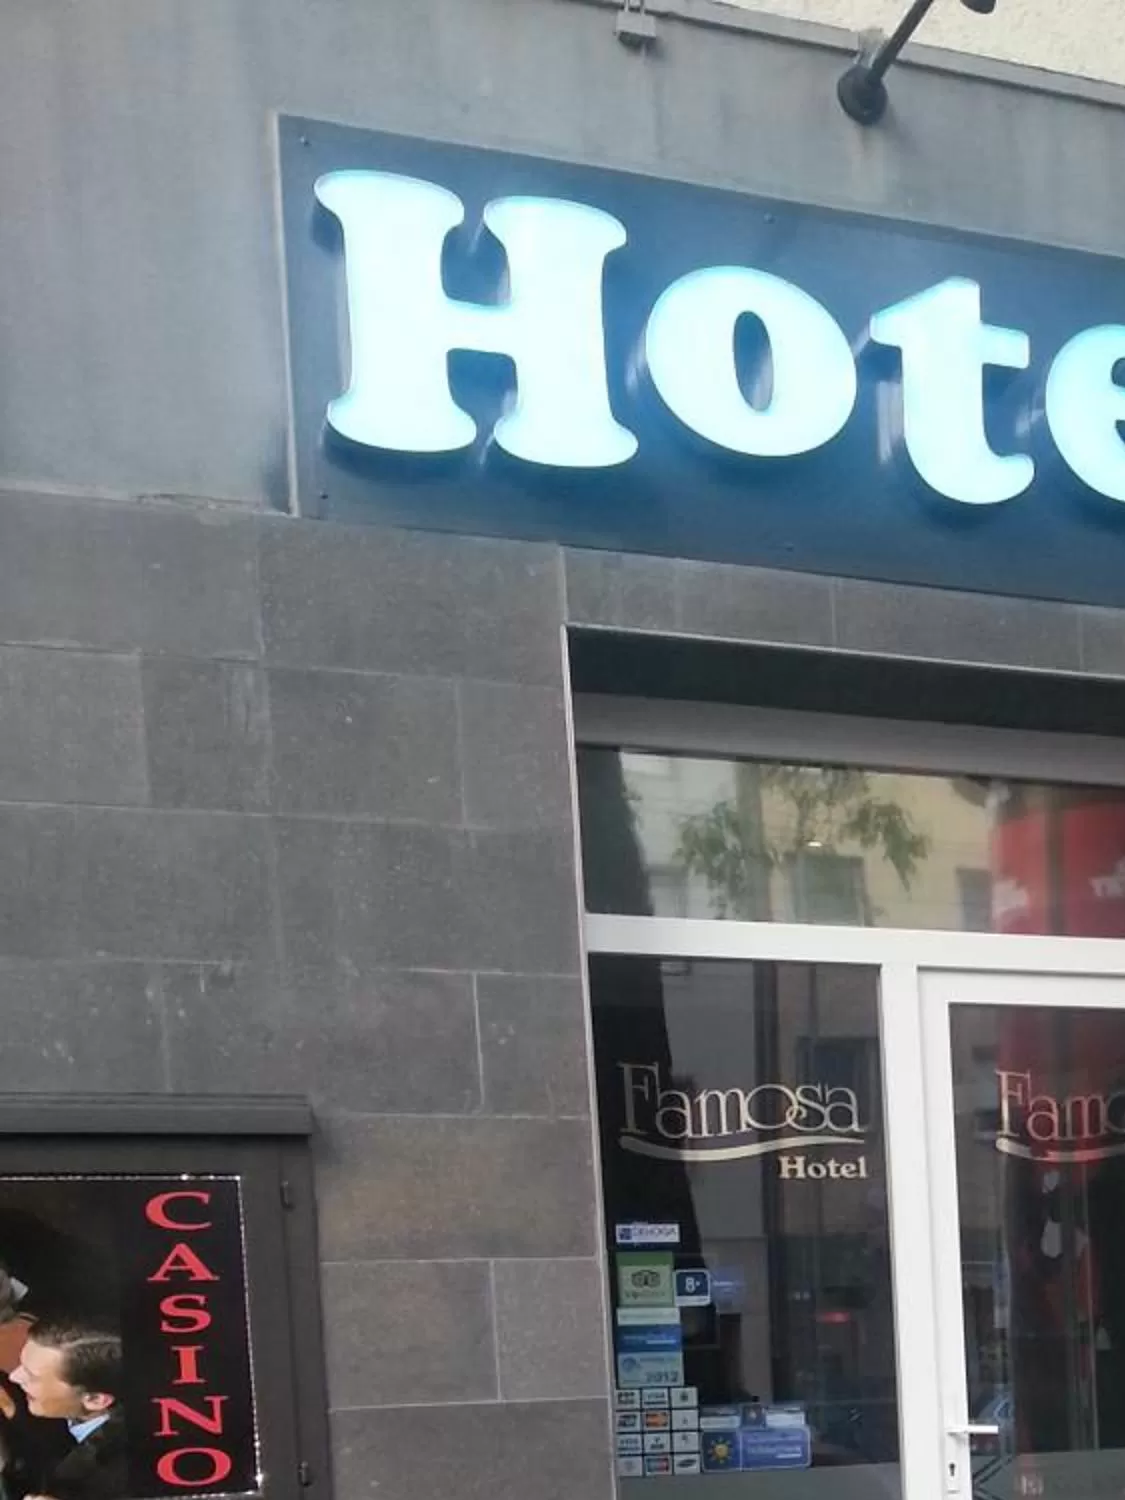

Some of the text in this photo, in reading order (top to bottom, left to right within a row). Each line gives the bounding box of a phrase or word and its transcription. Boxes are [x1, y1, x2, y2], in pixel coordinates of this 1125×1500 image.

[616, 1062, 867, 1140] Famosa
[777, 1154, 867, 1180] Hotel
[144, 1190, 233, 1488] CASINO
